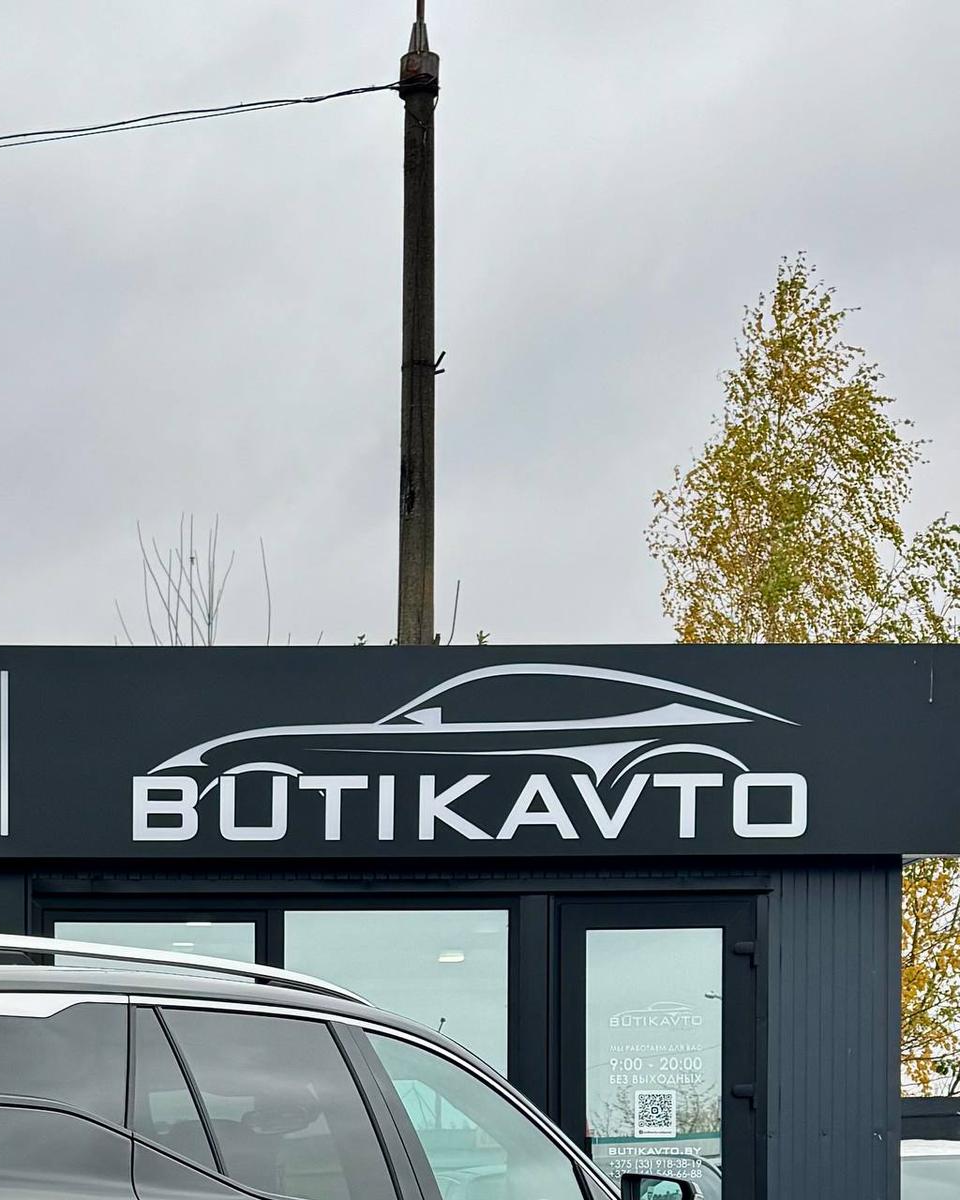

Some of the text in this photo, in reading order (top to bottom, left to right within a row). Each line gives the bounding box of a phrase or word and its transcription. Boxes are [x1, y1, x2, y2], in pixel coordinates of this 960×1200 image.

[132, 771, 808, 842] BUTIKAVTO
[609, 1016, 703, 1027] BUTIKAVTO
[610, 1058, 642, 1071] 9:00
[660, 1057, 702, 1071] 20:00
[609, 1074, 702, 1084] БЕЗ ВЫХОДНЫХ
[609, 1147, 702, 1155] BUTIKAVTO.BY
[610, 1159, 702, 1170] +375 (33) 918-38-19
